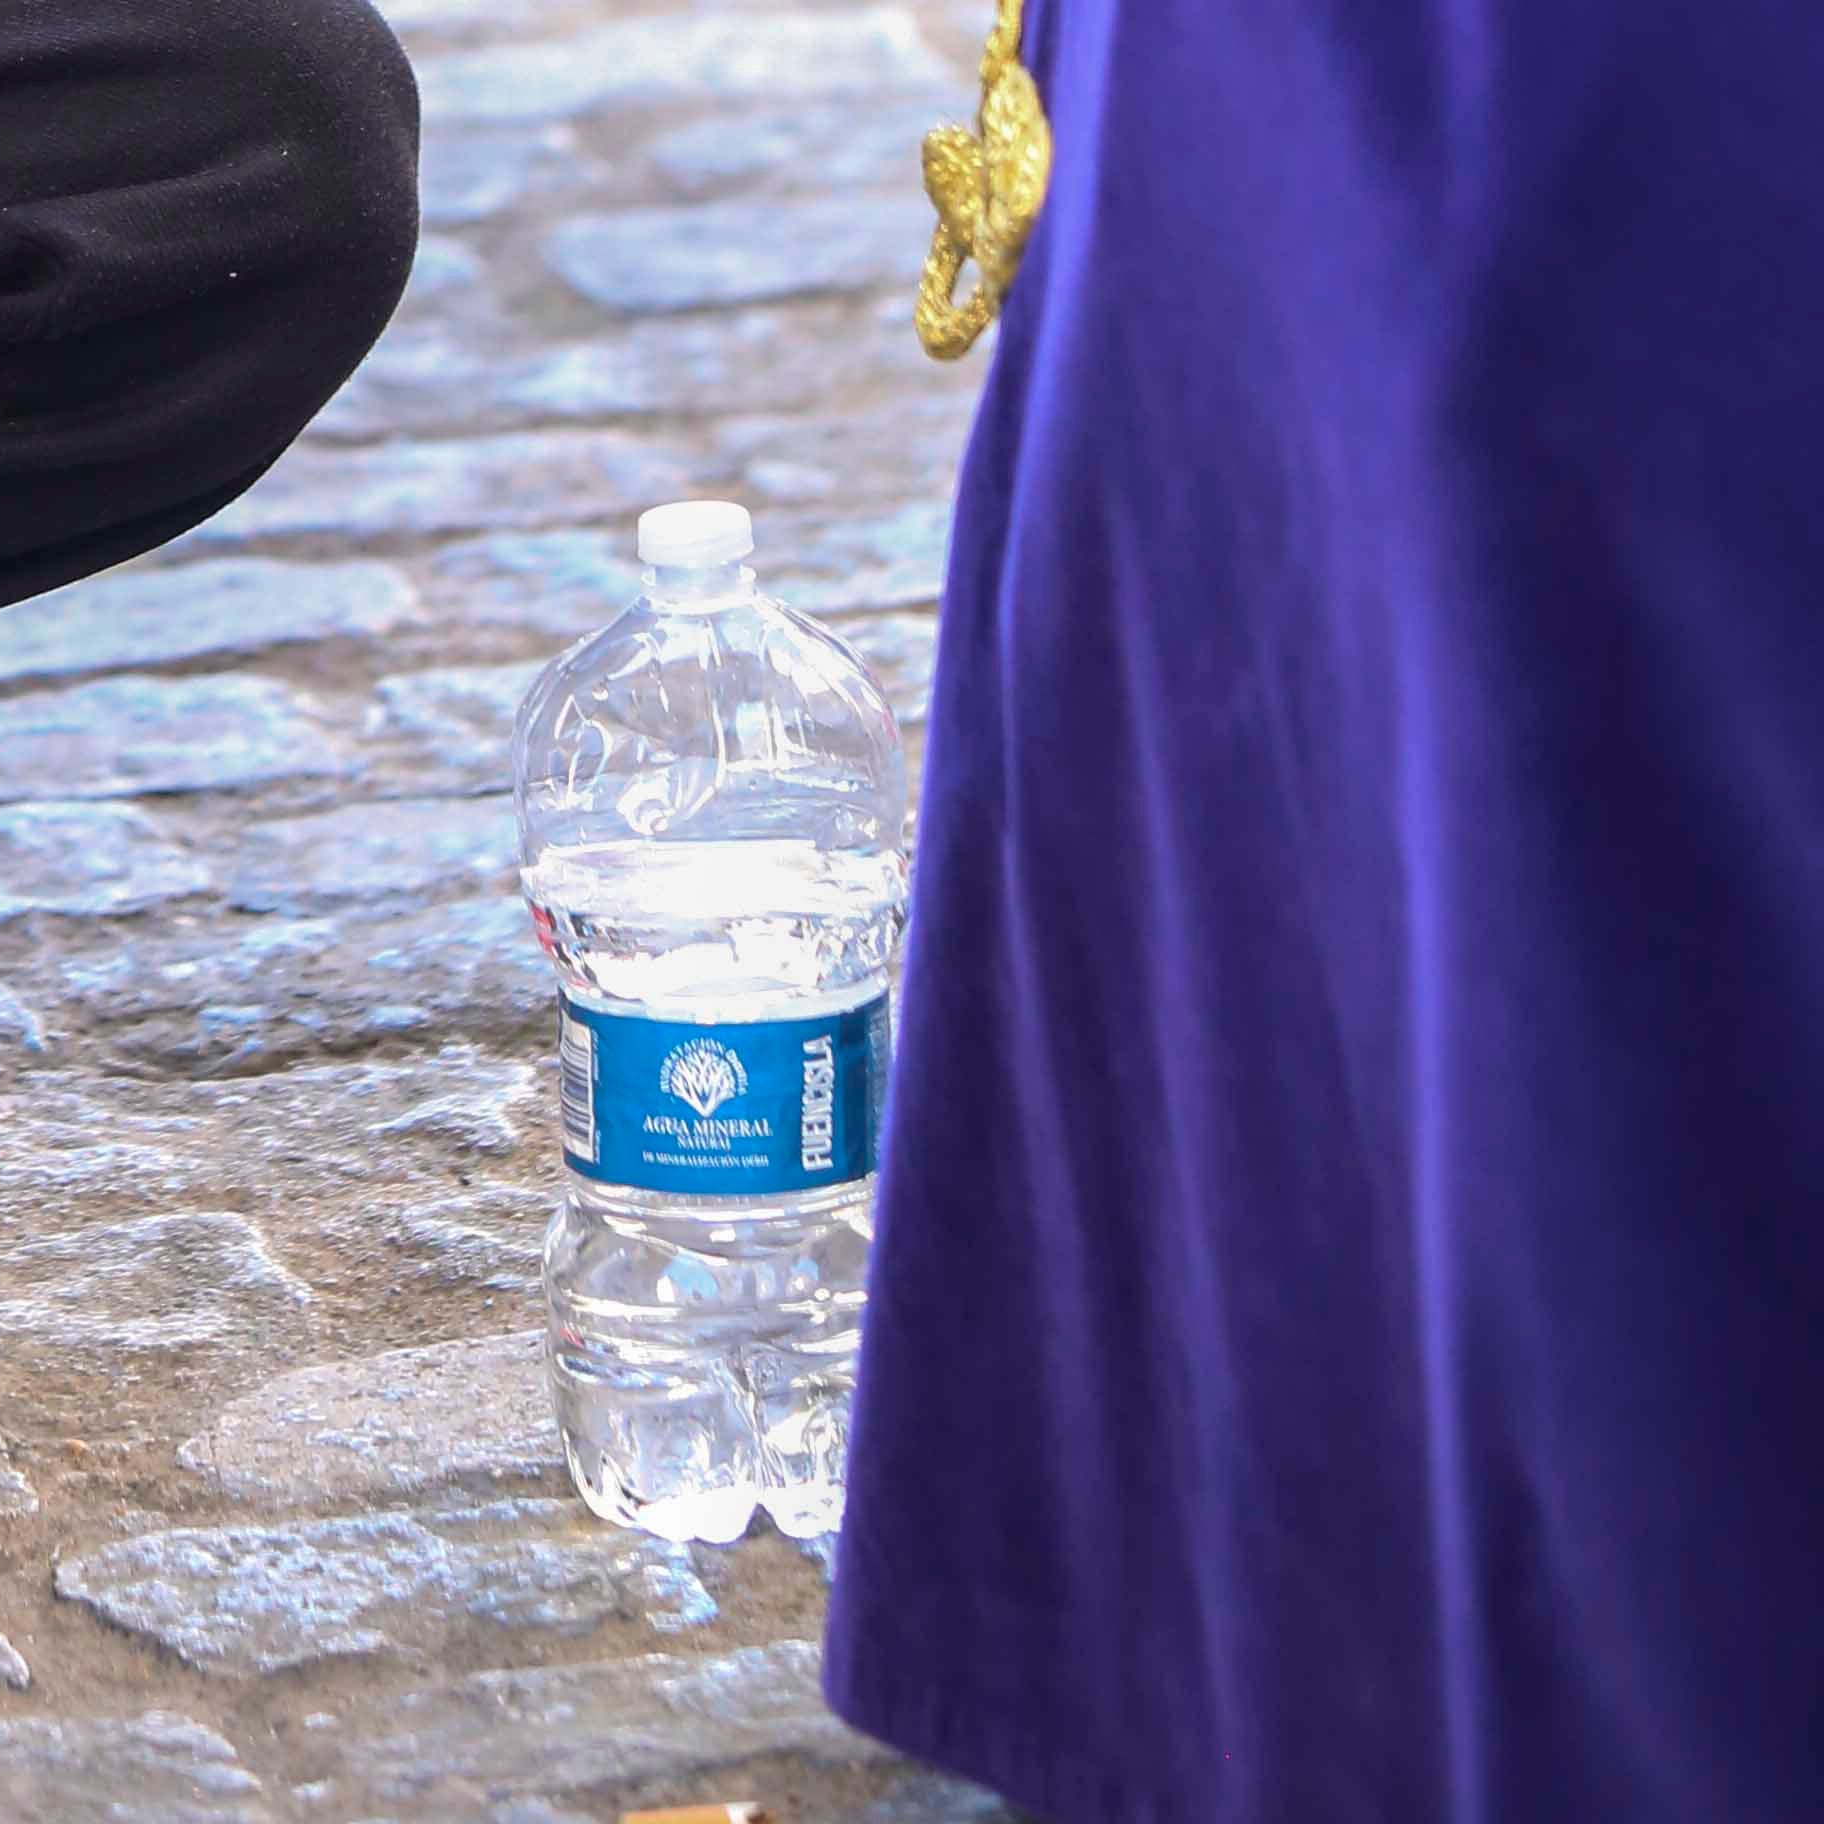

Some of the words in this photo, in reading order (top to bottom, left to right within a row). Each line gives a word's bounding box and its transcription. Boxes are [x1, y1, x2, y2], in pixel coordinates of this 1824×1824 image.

[642, 1113, 689, 1136] AGUA
[693, 1117, 774, 1138] MINERAL
[801, 1034, 835, 1172] FUENCISLA
